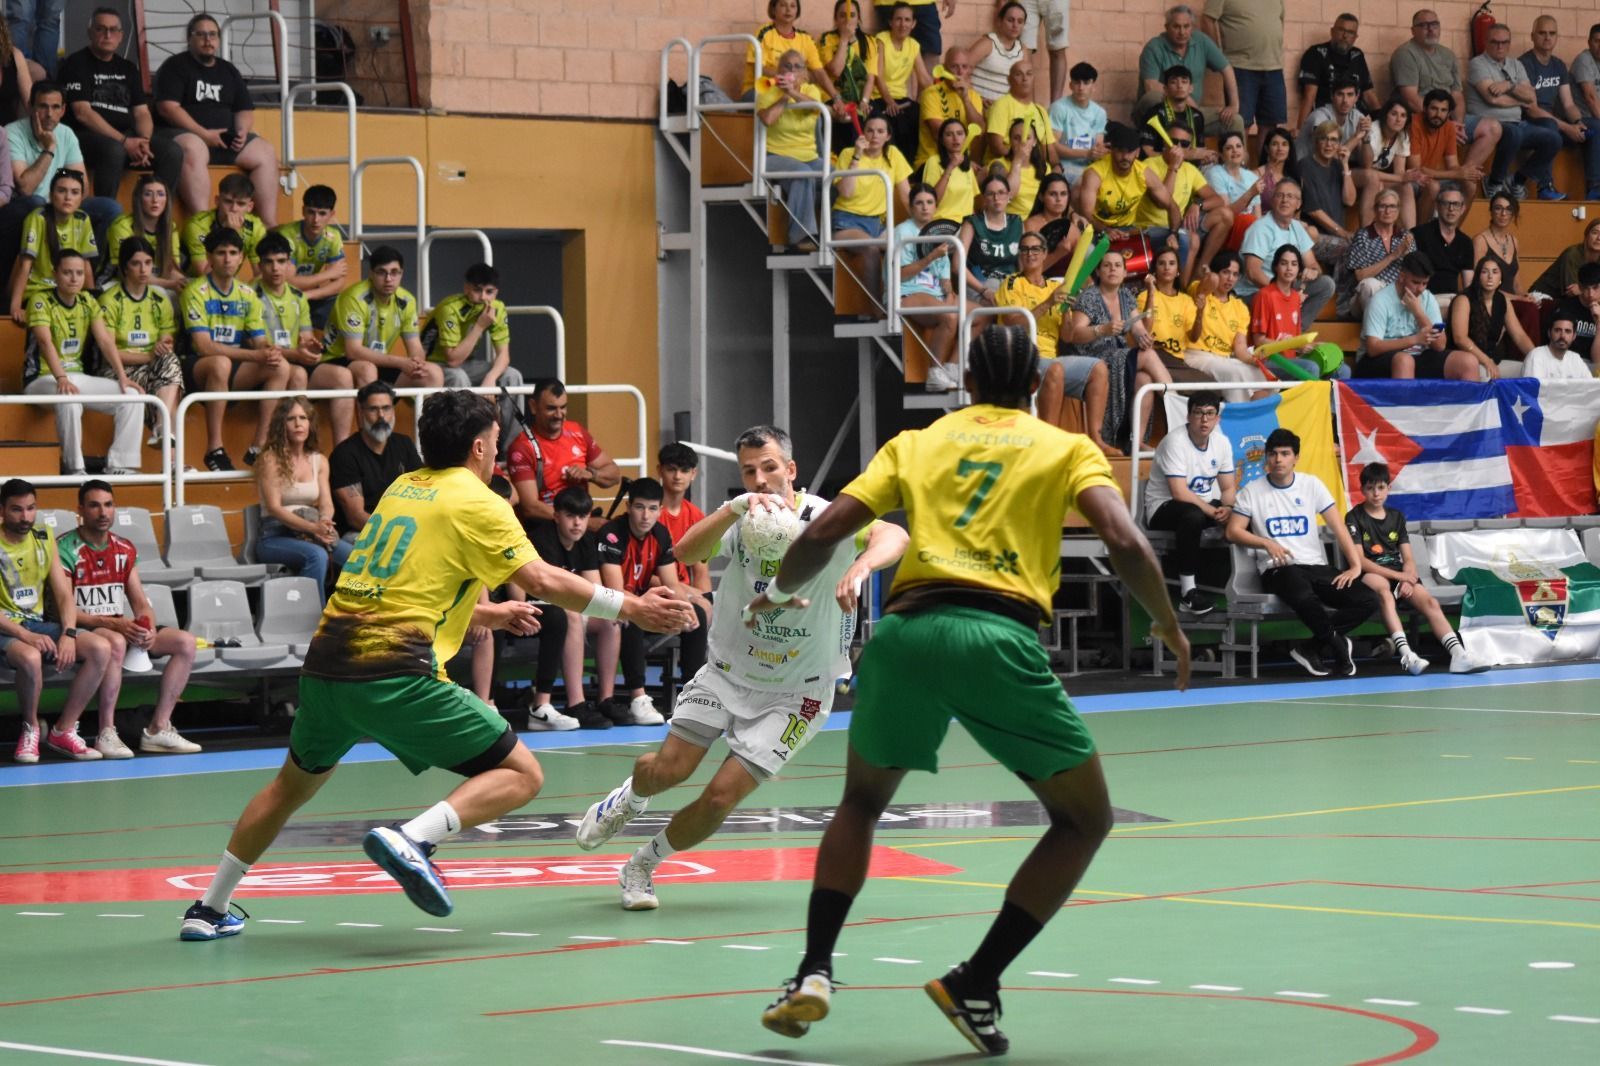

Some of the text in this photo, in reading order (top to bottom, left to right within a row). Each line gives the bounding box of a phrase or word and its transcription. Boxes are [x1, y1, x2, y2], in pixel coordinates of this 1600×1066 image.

[196, 80, 222, 102] CAT
[991, 243, 1005, 258] 71
[133, 314, 141, 330] 8
[945, 430, 1035, 448] SANTIAGO
[954, 457, 1004, 529] 7
[1268, 517, 1306, 536] CBM
[342, 513, 418, 579] 20
[954, 547, 991, 562] Islas
[918, 550, 993, 573] Canarias
[15, 588, 34, 600] gaza
[765, 625, 812, 638] RURAL
[780, 713, 808, 751] 19
